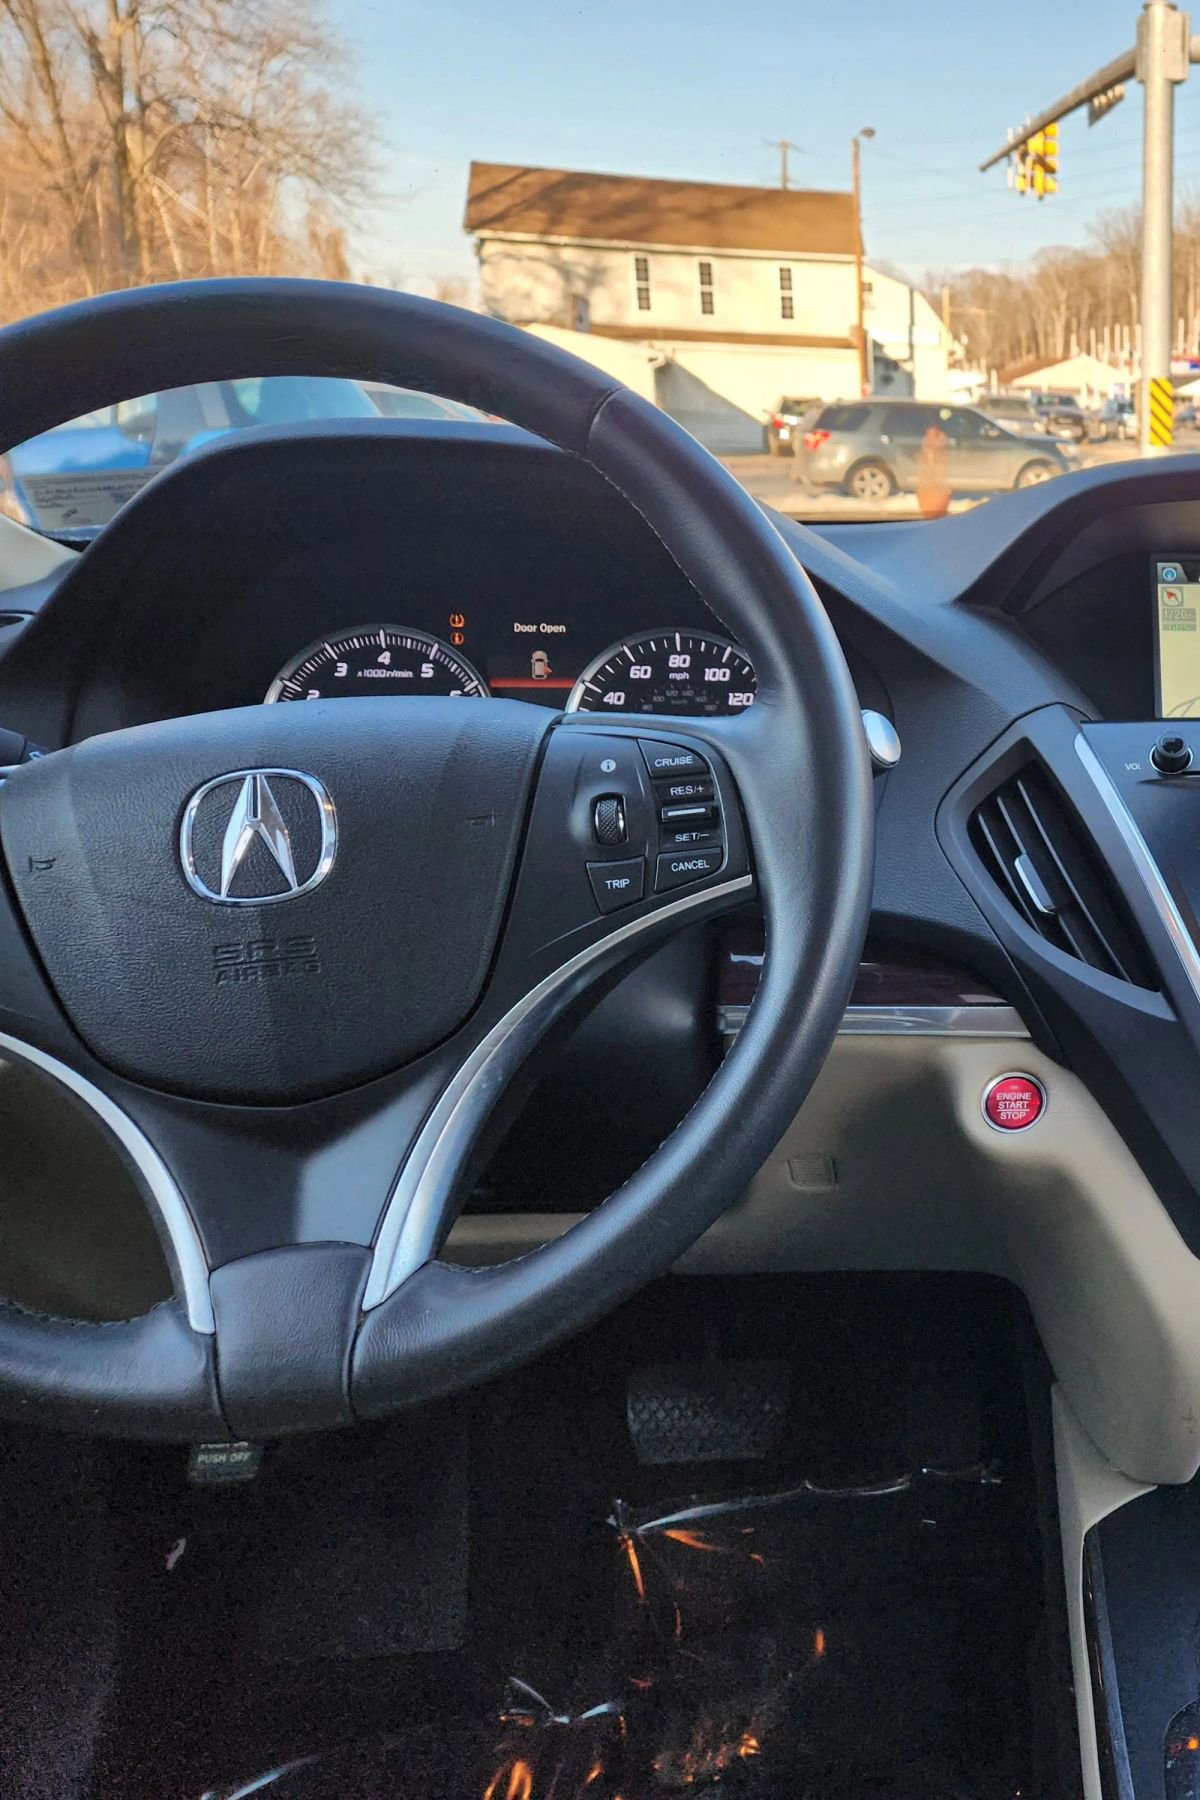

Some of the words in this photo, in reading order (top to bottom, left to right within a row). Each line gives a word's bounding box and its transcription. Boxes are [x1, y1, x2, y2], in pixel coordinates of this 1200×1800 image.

[514, 623, 537, 633] Door
[540, 623, 566, 634] Open
[377, 651, 392, 665] 4
[668, 655, 691, 668] 80
[334, 662, 348, 677] 3
[421, 663, 434, 678] 5
[629, 665, 652, 679] 60
[704, 668, 730, 681] 100
[669, 672, 690, 680] mph
[603, 692, 625, 705] 40
[728, 692, 754, 706] 120
[654, 756, 693, 767] CRUISE
[670, 785, 704, 796] RES/+
[671, 860, 710, 872] CANCEL
[605, 878, 630, 889] TRIP
[996, 1092, 1032, 1100] ENGINE
[998, 1101, 1029, 1109] START
